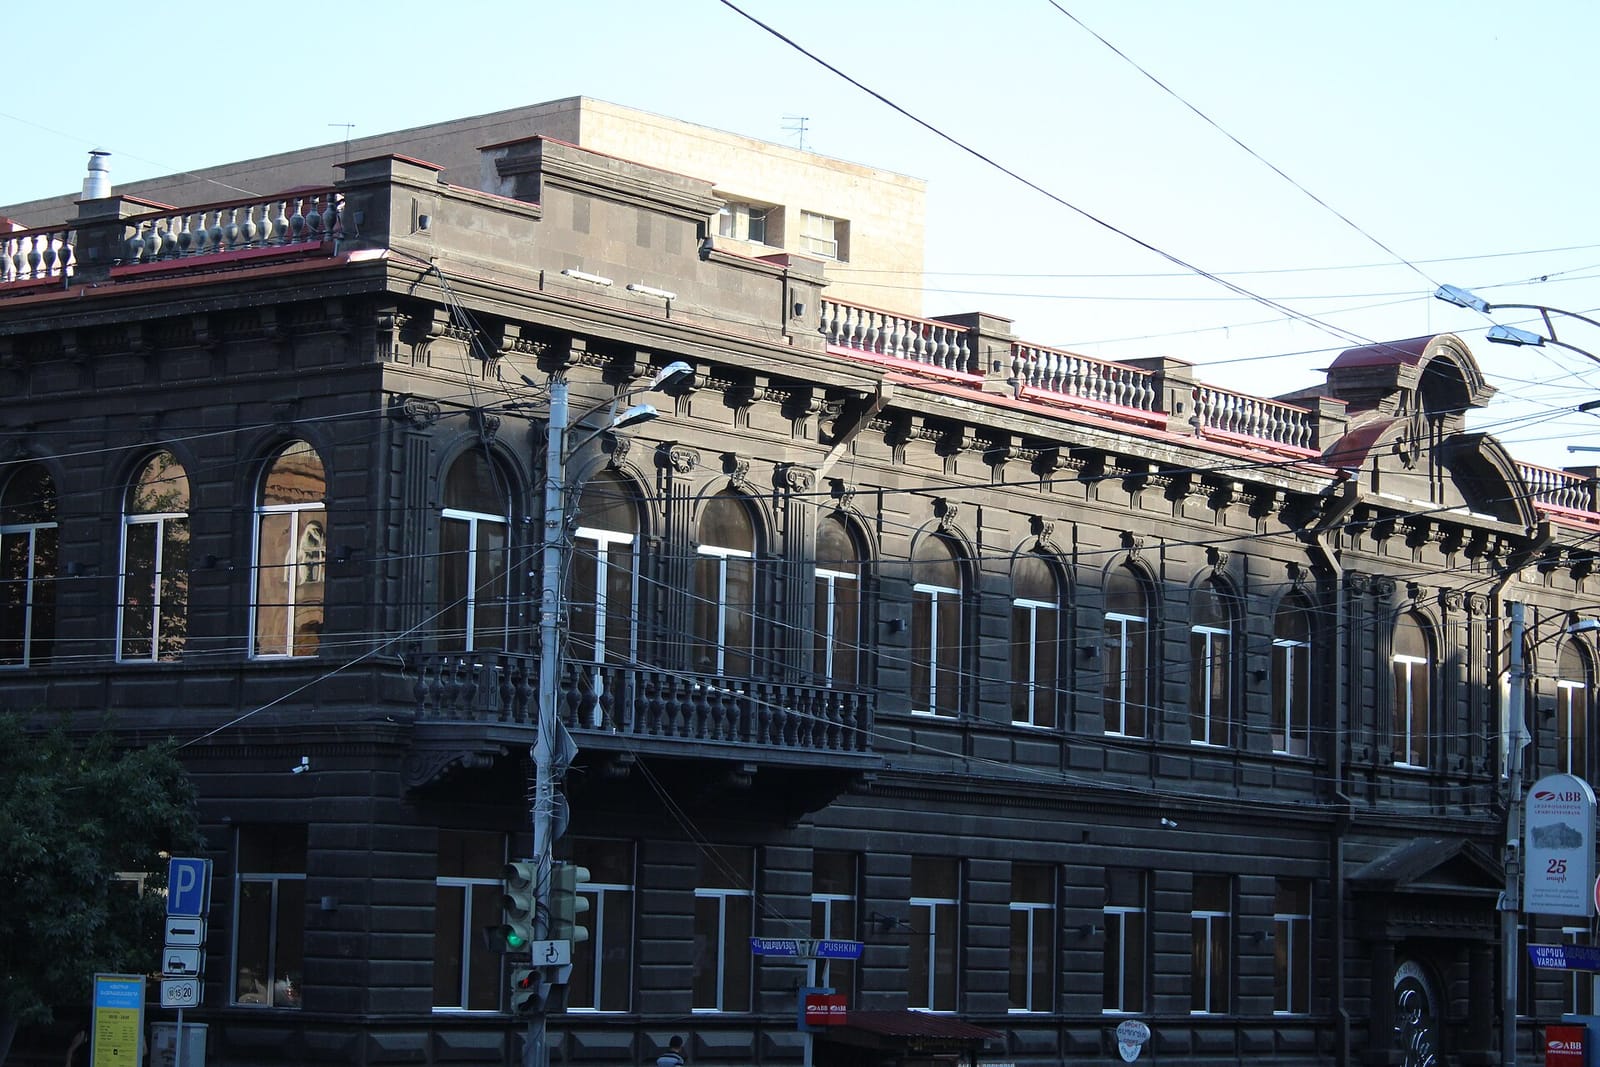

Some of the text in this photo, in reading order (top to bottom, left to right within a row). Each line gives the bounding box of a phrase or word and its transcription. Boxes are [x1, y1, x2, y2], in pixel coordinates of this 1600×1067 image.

[1556, 791, 1582, 802] ABB
[1546, 858, 1567, 874] 25
[175, 864, 196, 909] P
[824, 942, 857, 953] PUSHKIN
[175, 988, 181, 997] 15
[183, 987, 192, 998] 20
[1563, 1041, 1582, 1050] ABB
